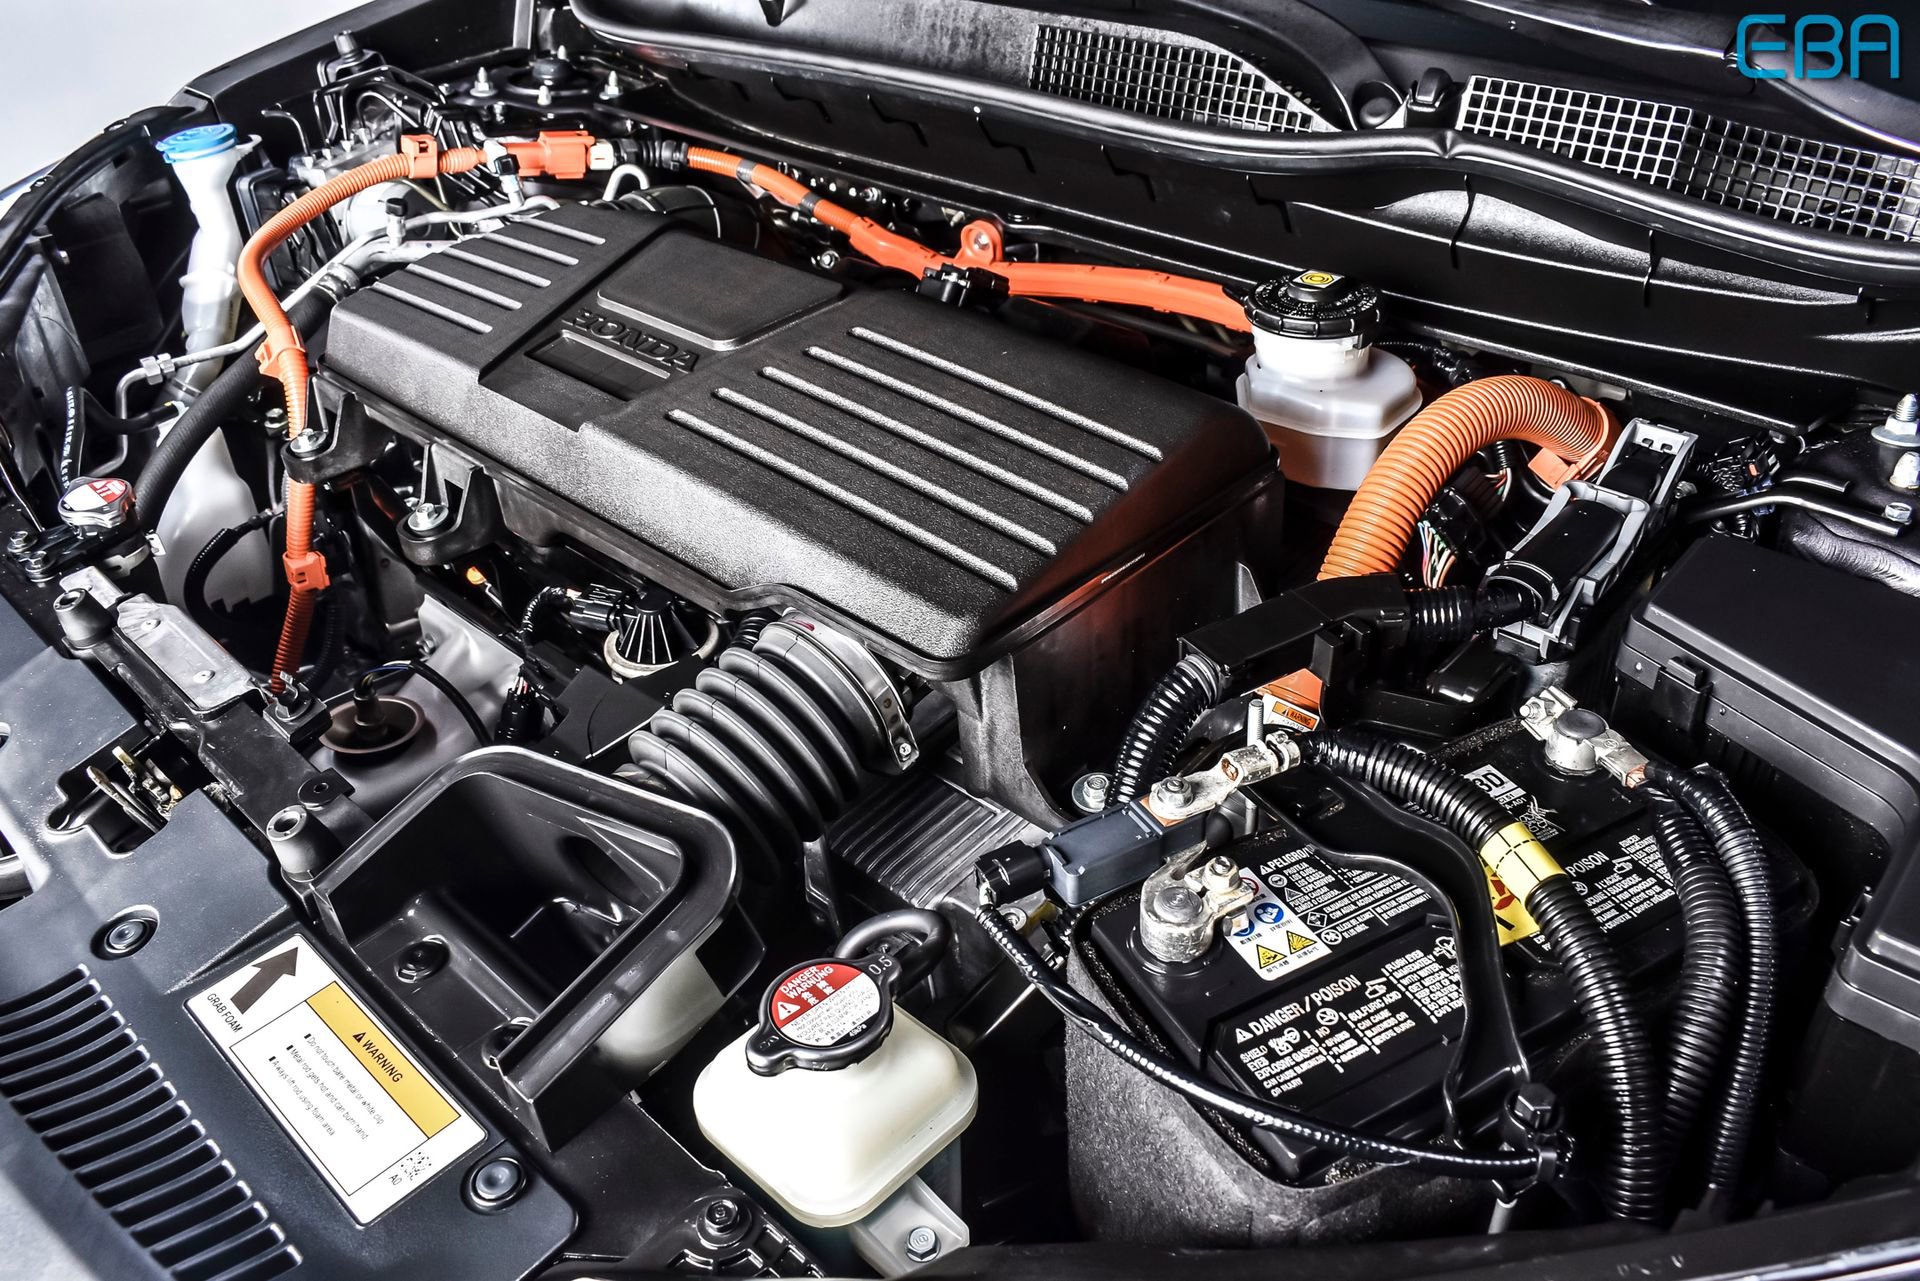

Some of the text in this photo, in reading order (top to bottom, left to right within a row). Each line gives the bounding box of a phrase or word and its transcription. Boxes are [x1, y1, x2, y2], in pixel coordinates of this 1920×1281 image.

[562, 308, 700, 374] HONDA
[1565, 851, 1609, 877] POISON
[1289, 873, 1302, 881] LOS
[1295, 871, 1325, 887] LOS GASES
[1301, 875, 1335, 893] EXPLOSIVOS
[1348, 892, 1361, 901] LOS
[868, 955, 893, 975] 0.5
[1385, 950, 1424, 972] FLUSH EYES
[1389, 954, 1436, 979] IMMEDIATELY
[780, 966, 819, 993] DANGER
[788, 966, 834, 999] WARNUNG
[1399, 973, 1420, 985] WITH
[1408, 982, 1423, 993] GET
[1421, 970, 1450, 986] MEDICAL
[207, 993, 243, 1033] GRAB FOAM
[1348, 991, 1402, 1021] SULFURIC ACID
[1396, 1011, 1409, 1021] OR
[1357, 1009, 1392, 1030] CAN CAUSE
[1315, 1024, 1330, 1038] NO
[362, 1039, 403, 1083] WARNING
[1240, 1045, 1268, 1063] SHIELD
[1246, 1057, 1269, 1072] EYES
[1254, 1044, 1319, 1080] EXPLOSIVE GASES
[290, 1048, 304, 1063] Metal
[302, 1062, 312, 1073] rod
[307, 1071, 320, 1084] gets
[319, 1082, 329, 1093] hot
[325, 1091, 338, 1104] and
[334, 1102, 346, 1113] can
[342, 1111, 356, 1125] burn
[307, 1036, 316, 1047] Do
[314, 1045, 324, 1055] not
[321, 1052, 335, 1068] touch
[333, 1066, 346, 1080] bare
[344, 1079, 359, 1094] metal
[362, 1100, 375, 1115] white
[1263, 1078, 1278, 1088] CAN
[1276, 1069, 1297, 1082] CAUSE
[1271, 1087, 1282, 1097] OR
[293, 1084, 303, 1096] rod
[300, 1094, 314, 1111] using
[312, 1107, 325, 1122] foam
[322, 1122, 336, 1136] area
